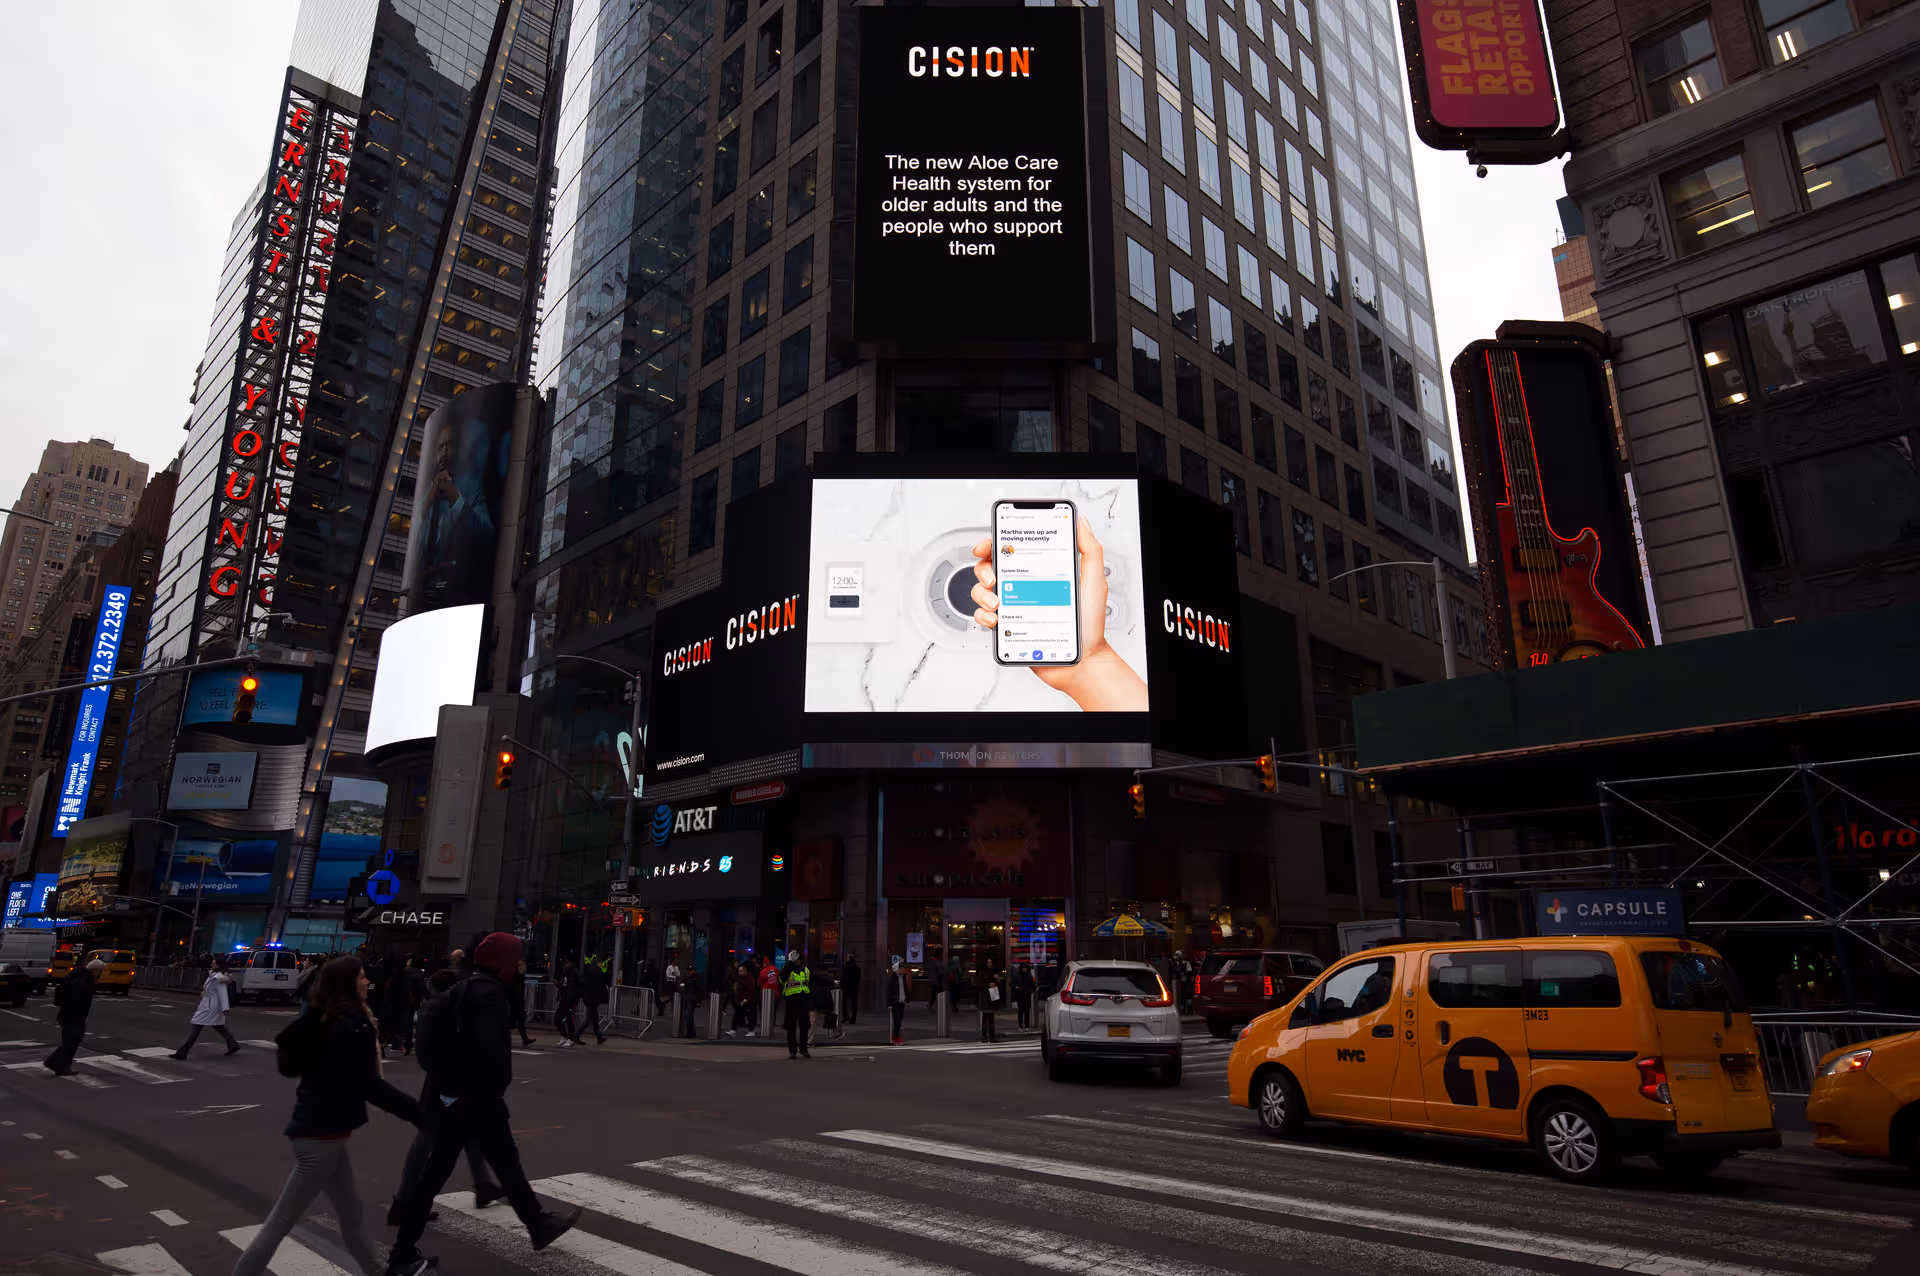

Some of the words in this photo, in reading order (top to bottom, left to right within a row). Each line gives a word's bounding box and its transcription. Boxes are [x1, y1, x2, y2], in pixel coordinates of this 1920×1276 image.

[908, 46, 1030, 78] CISION
[885, 155, 920, 170] The
[926, 158, 963, 170] new
[968, 155, 1009, 170] Aloe
[1014, 155, 1059, 170] Care
[267, 107, 311, 274] ERNST
[892, 175, 951, 191] Health
[957, 177, 1022, 194] system
[1027, 175, 1053, 191] for
[881, 197, 928, 212] older
[933, 197, 988, 213] adults
[993, 197, 1028, 213] and
[1033, 197, 1063, 213] the
[882, 219, 944, 237] people
[949, 219, 988, 234] who
[993, 219, 1063, 237] support
[949, 241, 995, 256] them
[251, 316, 279, 345] &
[209, 383, 268, 600] YOUNG
[726, 597, 797, 650] CISION
[1163, 598, 1230, 653] CISION
[664, 638, 711, 677] CISION
[80, 752, 91, 775] Frank
[656, 753, 705, 771] www.cision.com
[940, 752, 991, 760] THOMSON
[994, 752, 1040, 760] REUTERS
[65, 762, 79, 795] Newmark
[74, 774, 87, 796] Knight
[674, 805, 718, 834] AT&T
[380, 911, 444, 925] CHASE
[1577, 902, 1667, 916] CAPSULE
[1337, 1049, 1366, 1063] NYC
